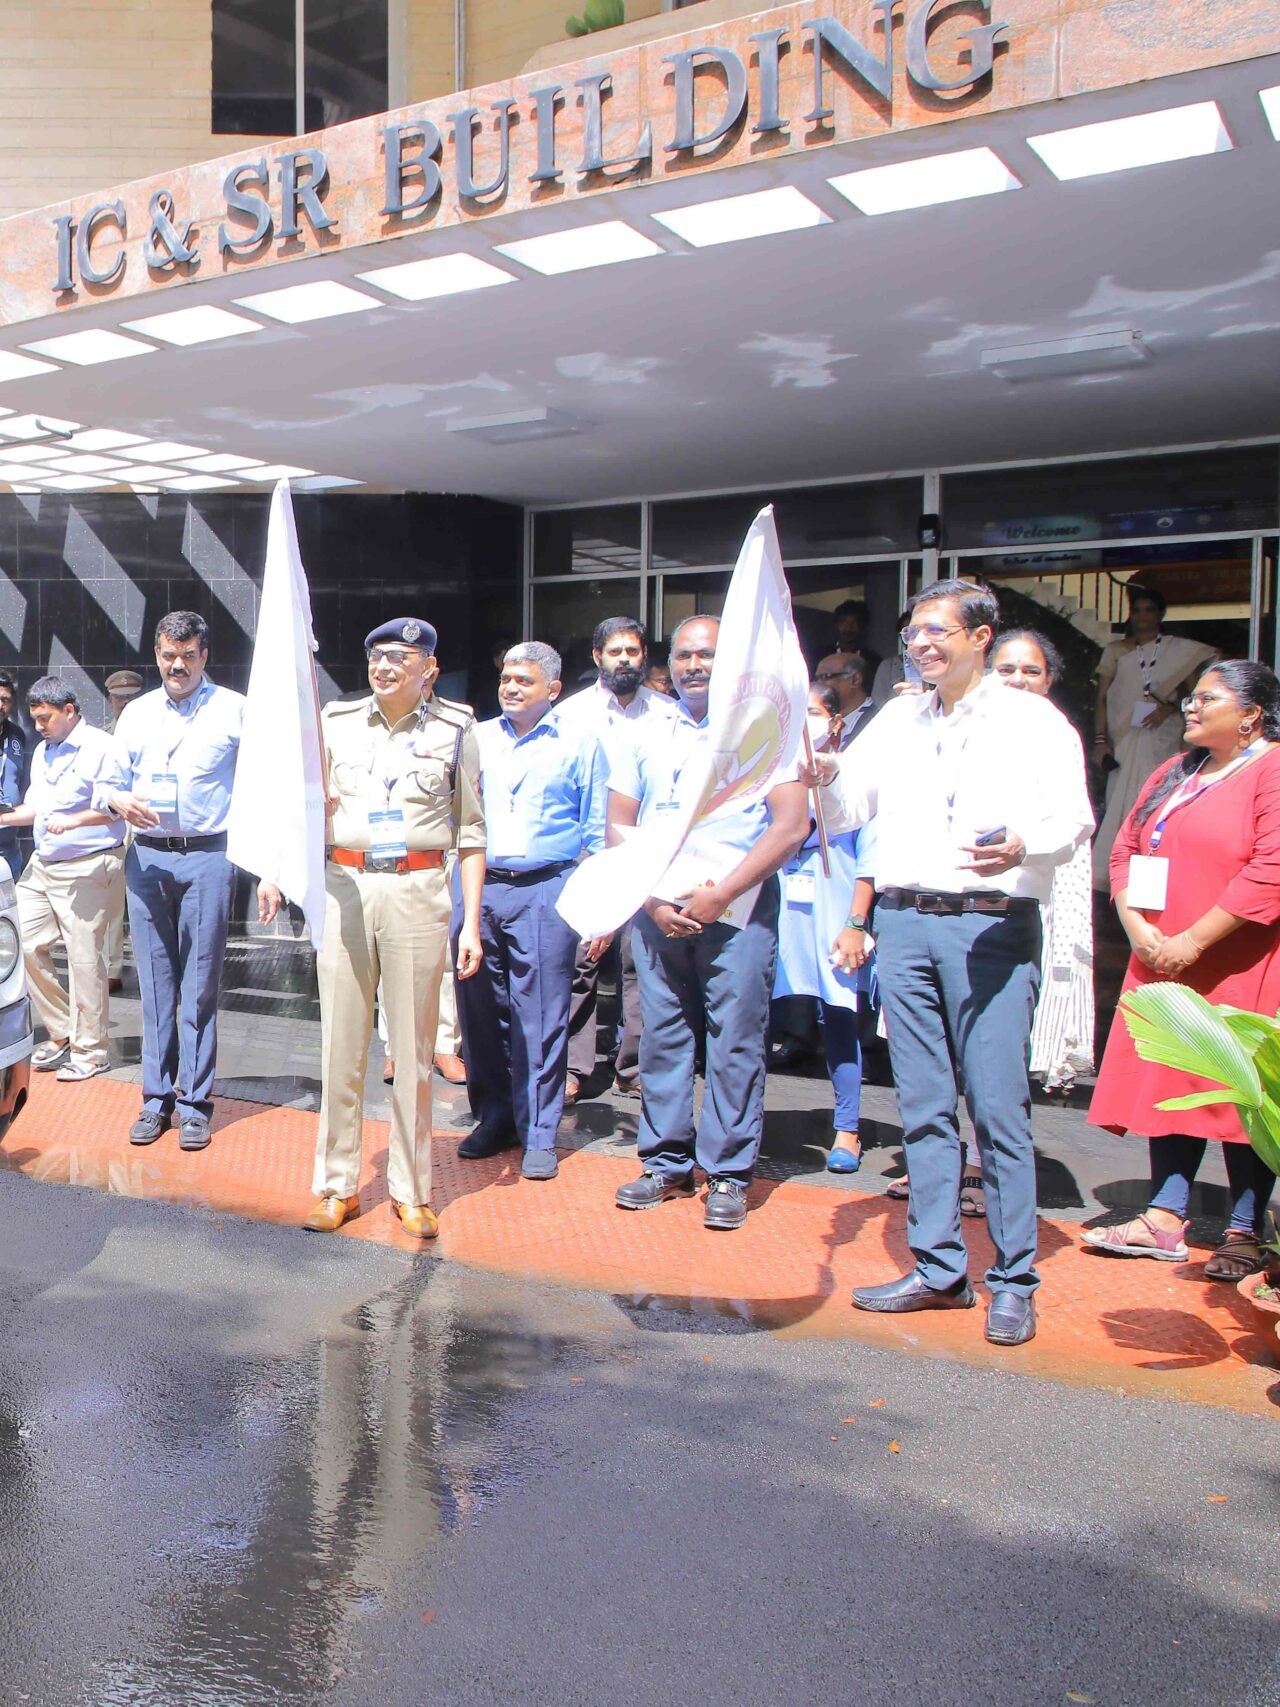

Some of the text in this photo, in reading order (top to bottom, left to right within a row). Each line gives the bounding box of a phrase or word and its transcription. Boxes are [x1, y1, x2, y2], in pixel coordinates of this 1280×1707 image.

[52, 0, 1009, 291] IC & SR BUILDING
[1001, 525, 1081, 540] Welcome
